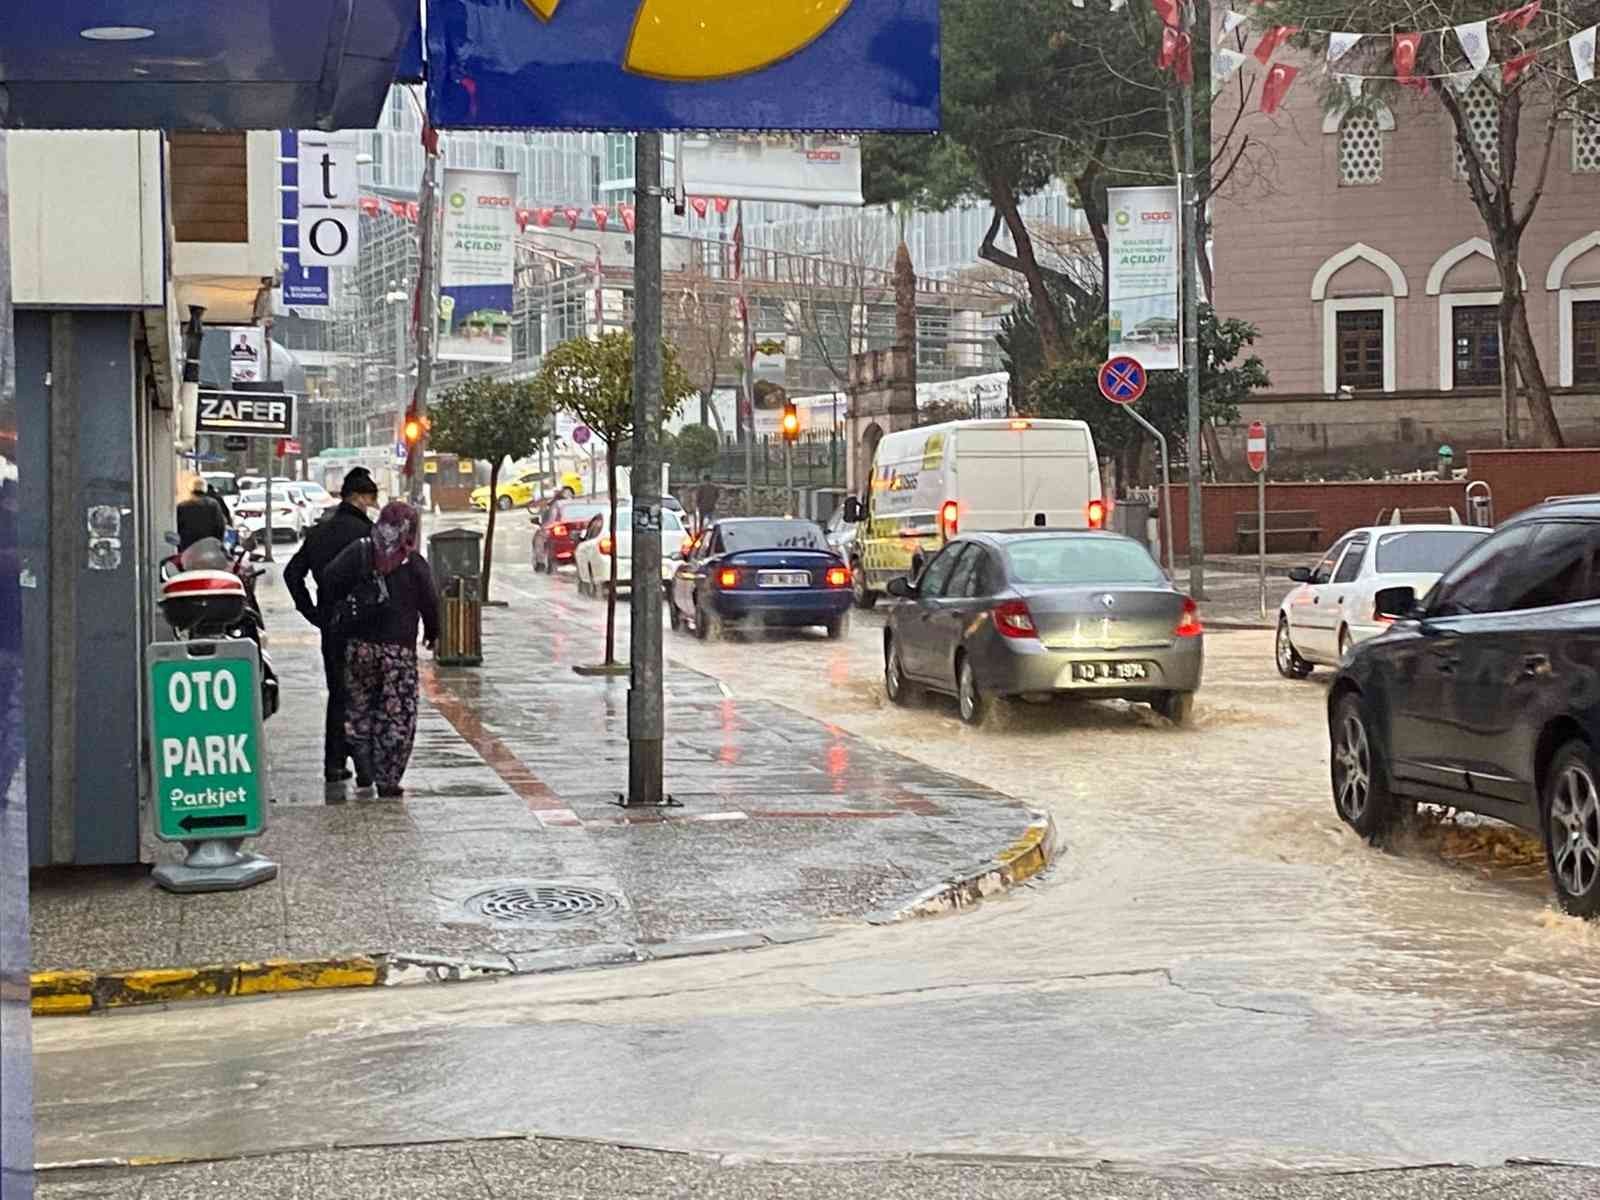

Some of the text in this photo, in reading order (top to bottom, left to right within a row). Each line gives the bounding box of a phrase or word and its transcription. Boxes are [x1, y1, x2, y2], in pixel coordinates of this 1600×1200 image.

[200, 399, 287, 421] ZAFER
[168, 669, 237, 713] OTO
[162, 733, 253, 778] PARK
[169, 786, 248, 809] Parkjet
